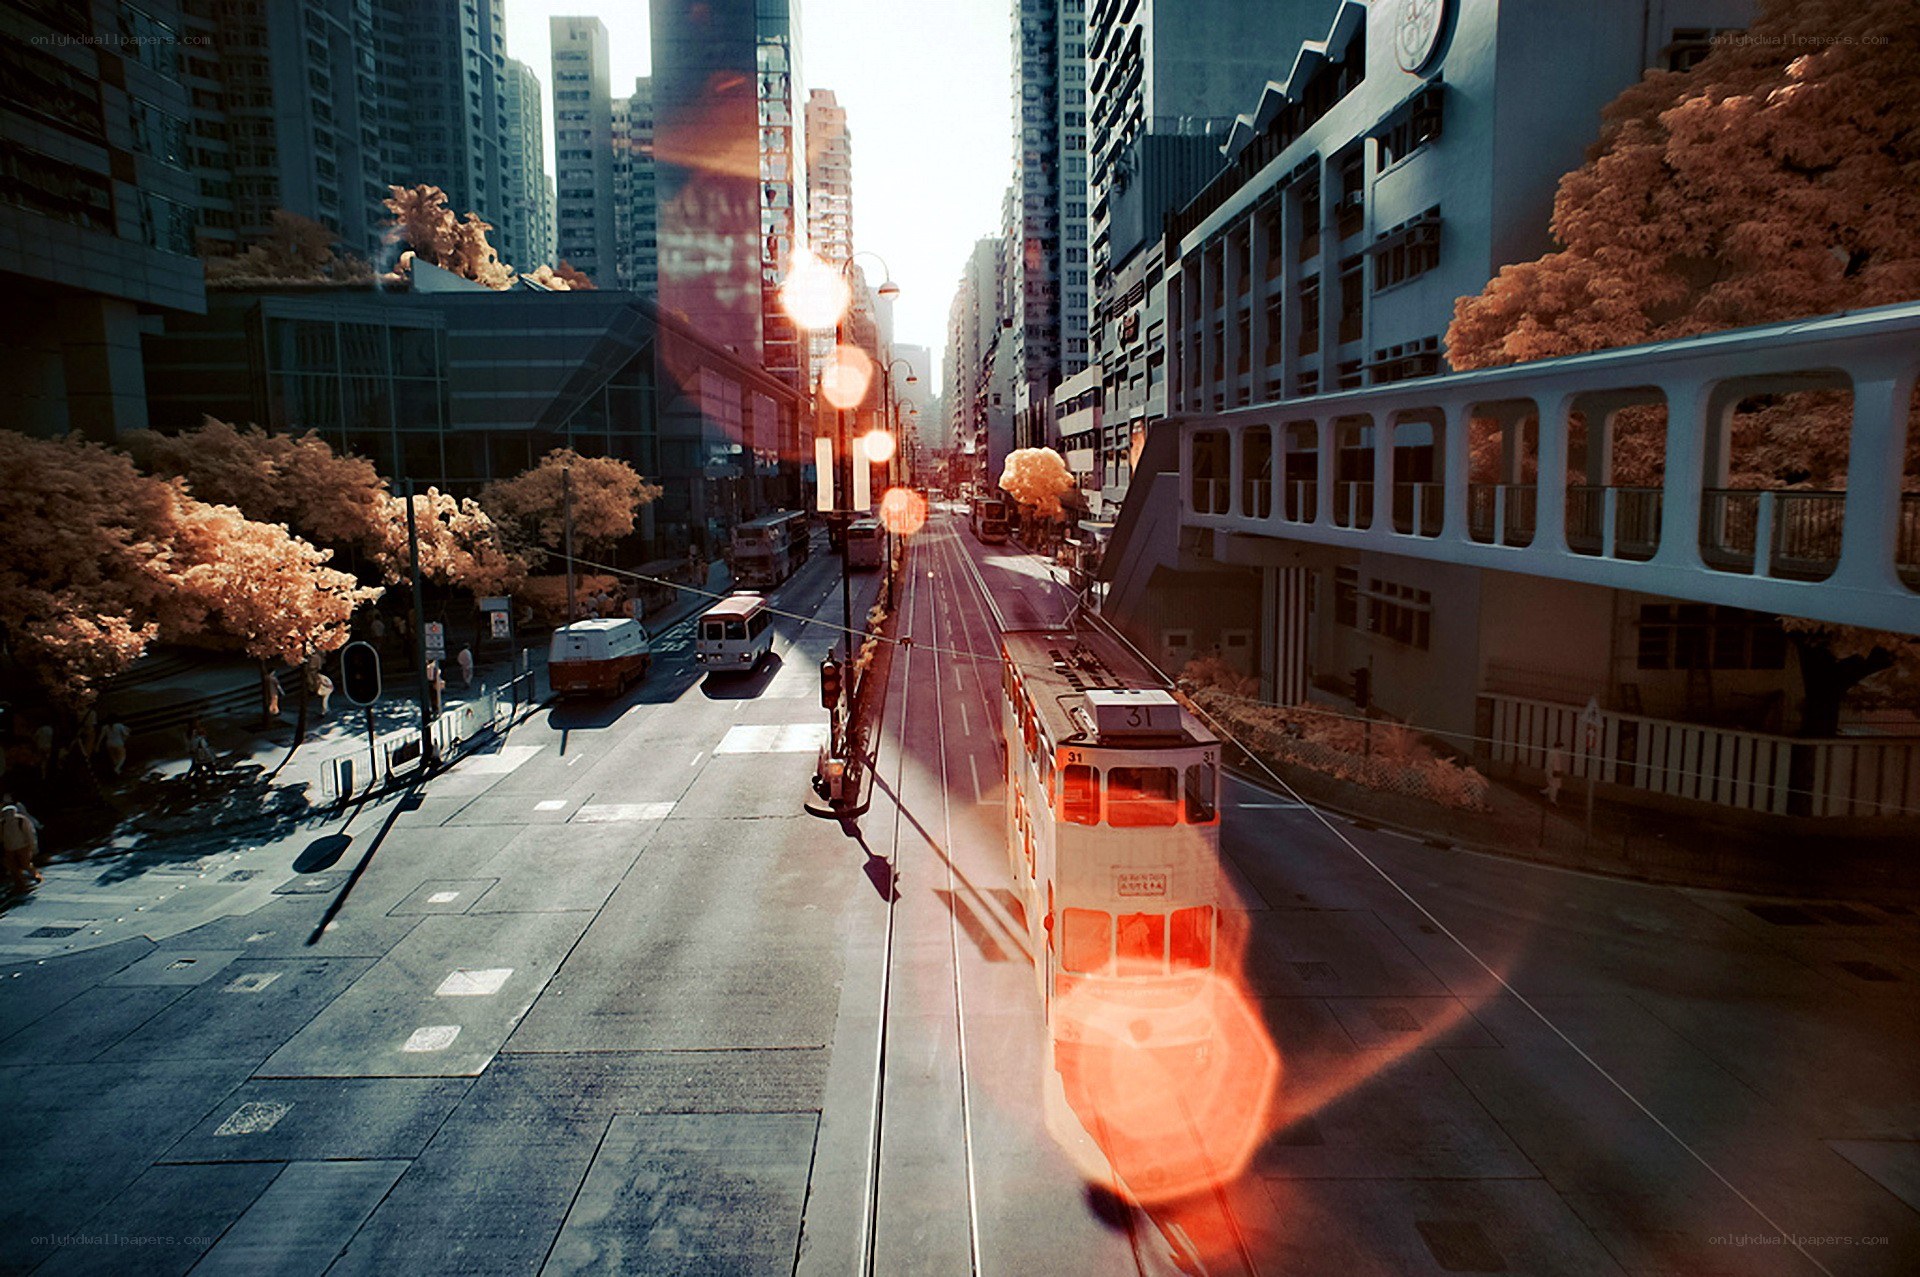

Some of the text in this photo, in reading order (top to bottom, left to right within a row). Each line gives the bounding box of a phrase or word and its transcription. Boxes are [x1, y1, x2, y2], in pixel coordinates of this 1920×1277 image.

[1126, 706, 1152, 728] 31
[1068, 752, 1083, 763] 31
[1203, 752, 1215, 763] 31
